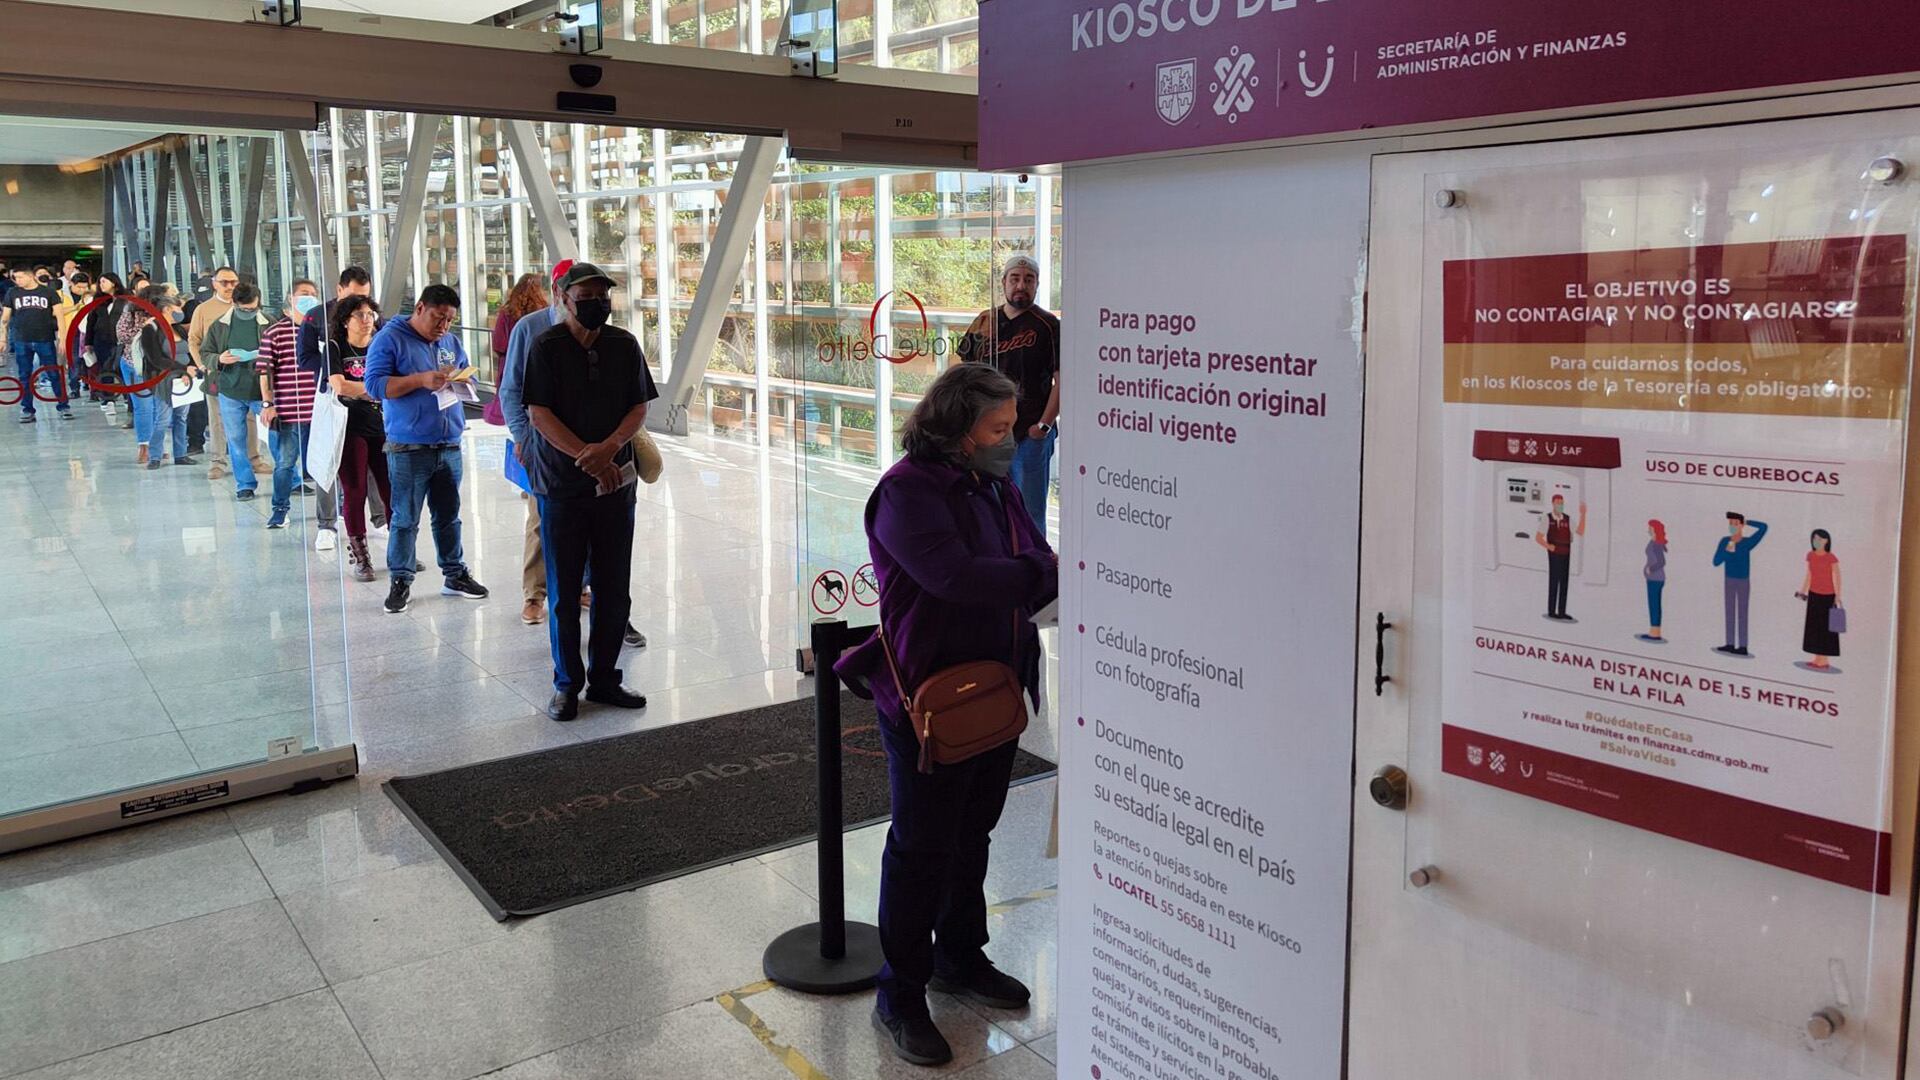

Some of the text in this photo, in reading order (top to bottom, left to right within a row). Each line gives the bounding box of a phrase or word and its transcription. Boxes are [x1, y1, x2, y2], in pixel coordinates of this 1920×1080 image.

[1072, 0, 1221, 51] KIOSCO
[1377, 29, 1497, 60] SECRETARÍA DE
[1377, 31, 1627, 79] ADMINISTRACIÓN Y FINANZAS
[15, 297, 48, 310] AERO
[1475, 301, 1857, 323] NO CONTAGIAR Y NO CONTAGIARSE
[1565, 278, 1731, 299] EL OBJETIVO ES
[1100, 308, 1196, 336] Para pago
[1099, 344, 1317, 377] con tarjeta presentar
[1550, 355, 1748, 375] Para cuidarnos todos,
[1099, 373, 1326, 417] identificación original
[1462, 378, 1481, 389] en
[1484, 375, 1505, 388] los
[1510, 376, 1573, 391] Kioscos
[1577, 377, 1598, 392] de
[1603, 378, 1618, 392] la
[1624, 378, 1711, 395] Tesorería
[1717, 382, 1739, 396] es
[1098, 408, 1237, 444] oficial vigente
[1562, 446, 1583, 455] SAF
[1646, 459, 1840, 485] USO DE CUBREBOCAS
[1097, 466, 1177, 498] Credencial
[1097, 497, 1172, 530] de elector
[1097, 562, 1172, 598] Pasaporte
[1096, 626, 1243, 690] Cédula profesional
[1475, 636, 1839, 716] GUARDAR SANA DISTANCIA DE 1.5 METROS
[1096, 660, 1200, 709] con fotografía
[1593, 677, 1685, 707] EN LA FILA
[1096, 719, 1183, 770] Documento
[1522, 710, 1769, 774] y realiza tus trámites en finanzas.cdmx.gob.mx
[1585, 710, 1693, 743] #QuédateEnCasa
[1600, 741, 1676, 767] #SalvaVidas
[1095, 754, 1264, 837] con el que se acredite
[1094, 784, 1295, 885] su estadía legal en el país
[1094, 820, 1227, 894] Reportes o quejas sobre
[1094, 840, 1301, 954] la atención brindada en este Kiosco
[1108, 872, 1236, 949] LOCATEL 55 5658 1111
[1093, 904, 1211, 978] Ingresa solicitudes de
[1093, 923, 1281, 1044] información, dudas, sugerencias,
[1093, 947, 1259, 1054] comentarios, requerimientos,
[1092, 967, 1126, 993] quejas
[1128, 987, 1135, 1001] y
[1137, 993, 1171, 1020] avisos
[1174, 1015, 1205, 1042] sobre
[1209, 1032, 1219, 1050] la
[1092, 987, 1138, 1021] comisión
[1141, 1015, 1155, 1032] de
[1158, 1023, 1194, 1057] ilícitos
[1197, 1051, 1211, 1068] en
[1215, 1058, 1225, 1076] la
[1092, 1005, 1104, 1021] de
[1107, 1014, 1150, 1050] trámites
[1152, 1044, 1159, 1058] y
[1092, 1025, 1107, 1043] del
[1110, 1035, 1151, 1072] Sistema
